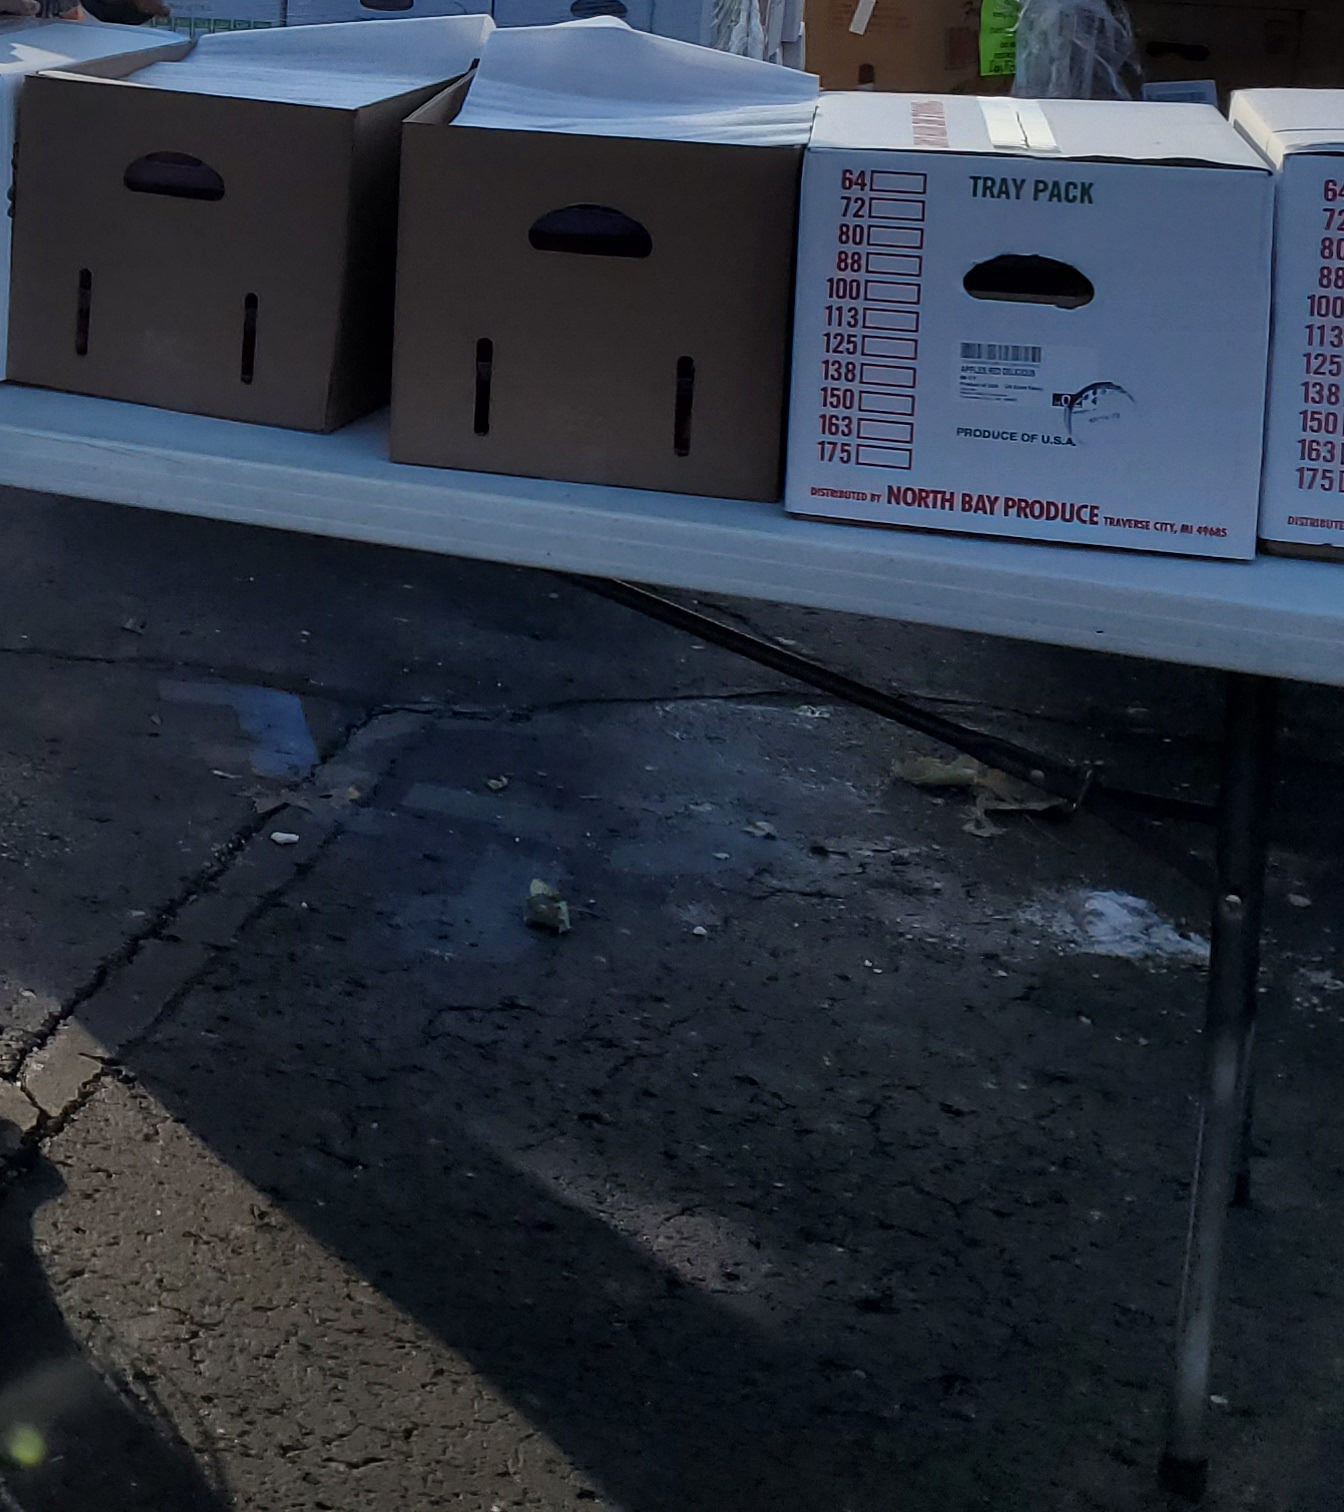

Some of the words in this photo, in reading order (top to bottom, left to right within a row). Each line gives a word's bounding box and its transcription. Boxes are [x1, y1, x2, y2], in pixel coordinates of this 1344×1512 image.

[841, 169, 867, 191] 64
[969, 176, 1026, 200] TRAY
[1033, 179, 1094, 204] PACK
[840, 196, 866, 218] 72
[838, 223, 864, 245] 80
[1320, 237, 1344, 260] 80
[836, 250, 862, 272] 88
[827, 277, 861, 300] 100
[1318, 266, 1344, 289] 88
[825, 305, 859, 328] 113
[1307, 294, 1344, 318] 100
[823, 332, 858, 355] 125
[1305, 324, 1343, 347] 113
[822, 359, 856, 382] 138
[1303, 352, 1342, 377] 125
[820, 386, 854, 409] 150
[1301, 381, 1340, 406] 138
[819, 413, 853, 437] 163
[1299, 410, 1338, 435] 150
[956, 427, 1019, 442] PRODUCE
[1021, 432, 1038, 443] OF
[817, 440, 852, 464] 175
[1297, 439, 1336, 463] 163
[1295, 467, 1334, 492] 175
[810, 486, 868, 501] DISTRIBUTED
[870, 493, 882, 503] BY
[886, 484, 955, 512] NORTH
[960, 492, 999, 516] BAY
[1003, 496, 1100, 525] PRODUCE
[1103, 516, 1151, 530] TRAVERSE
[1153, 521, 1178, 534] CITY,
[1180, 523, 1193, 534] MI
[1287, 516, 1344, 531] DISTRIBUTE
